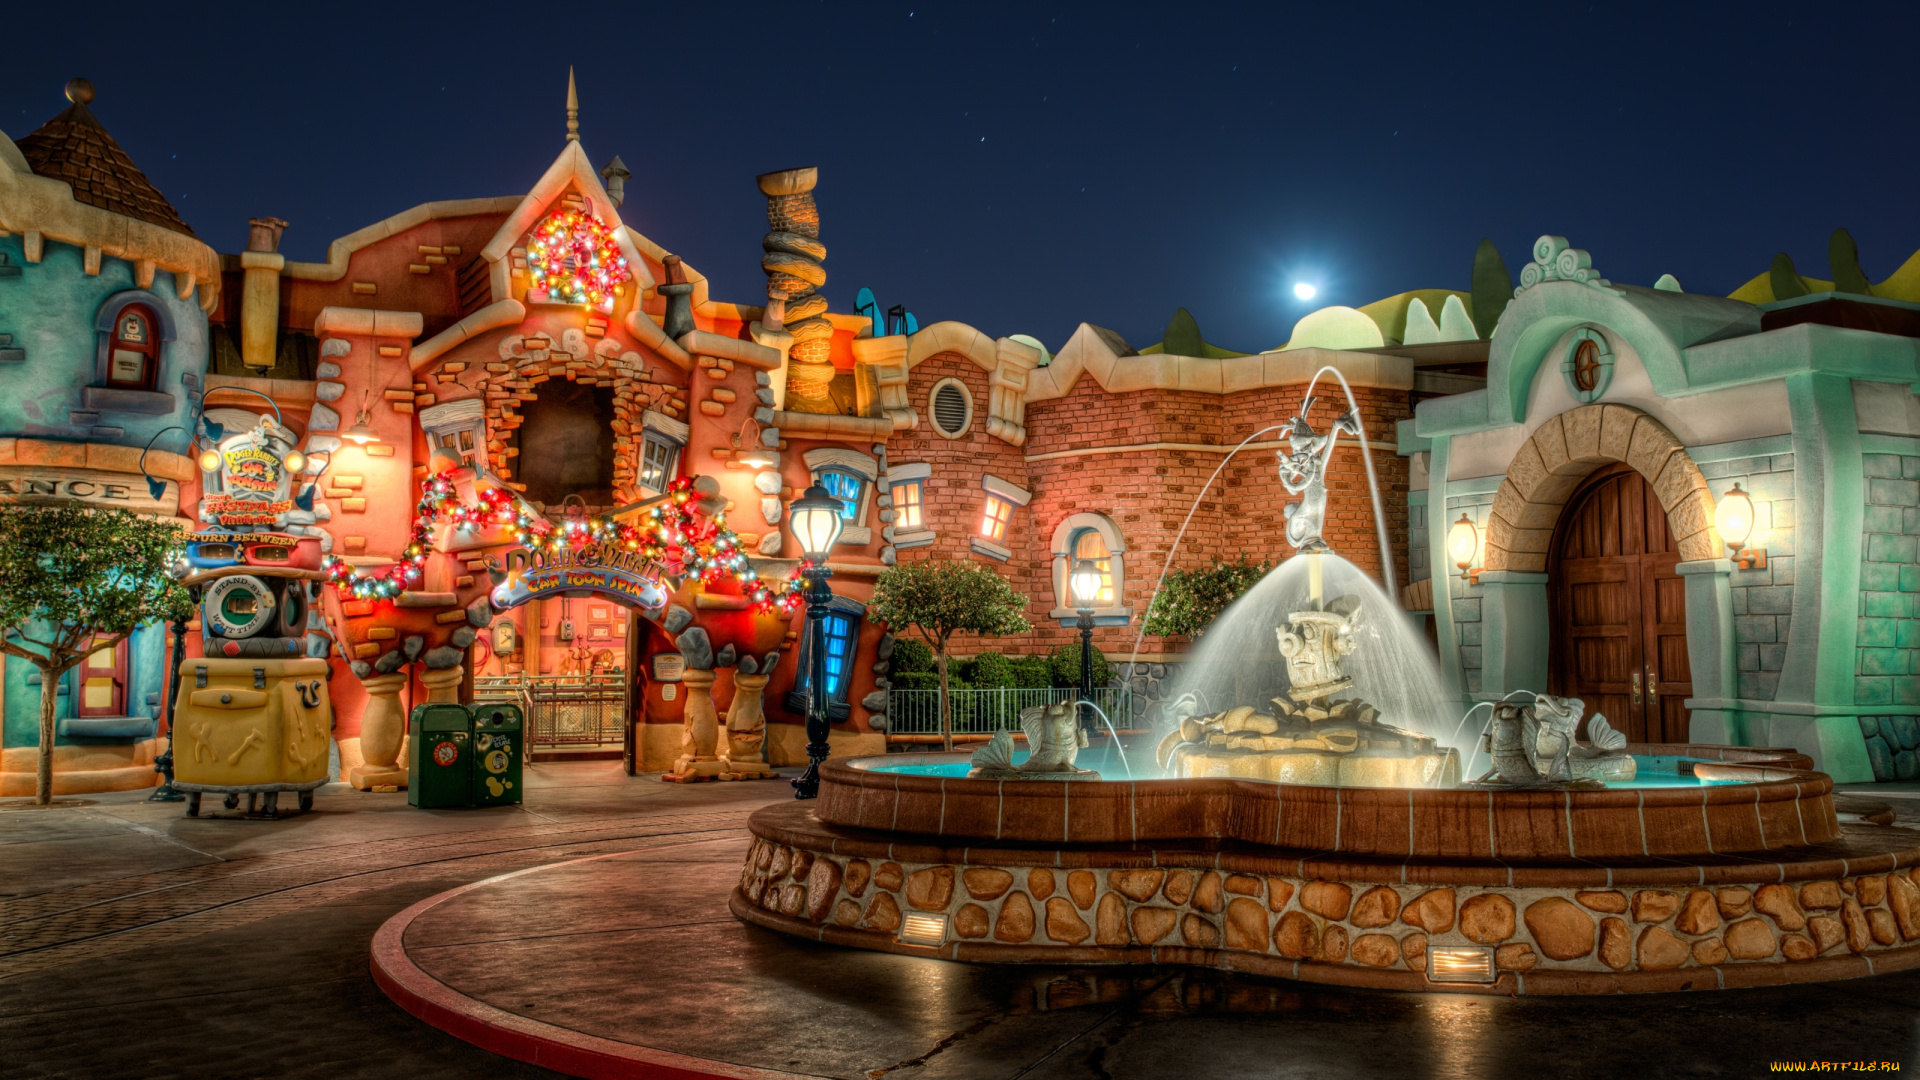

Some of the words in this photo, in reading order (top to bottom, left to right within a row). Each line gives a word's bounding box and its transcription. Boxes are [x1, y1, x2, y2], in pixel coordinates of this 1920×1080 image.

[241, 462, 264, 475] CAR
[205, 500, 292, 514] FASTPASS
[171, 530, 229, 543] RETURN
[232, 533, 299, 546] BETWEEN
[234, 543, 246, 562] &
[505, 549, 579, 591] ROGER
[215, 577, 262, 596] STAND-BY
[527, 574, 561, 592] CAR
[566, 571, 605, 587] TOON
[609, 575, 644, 598] SPIN
[237, 614, 260, 634] TIME
